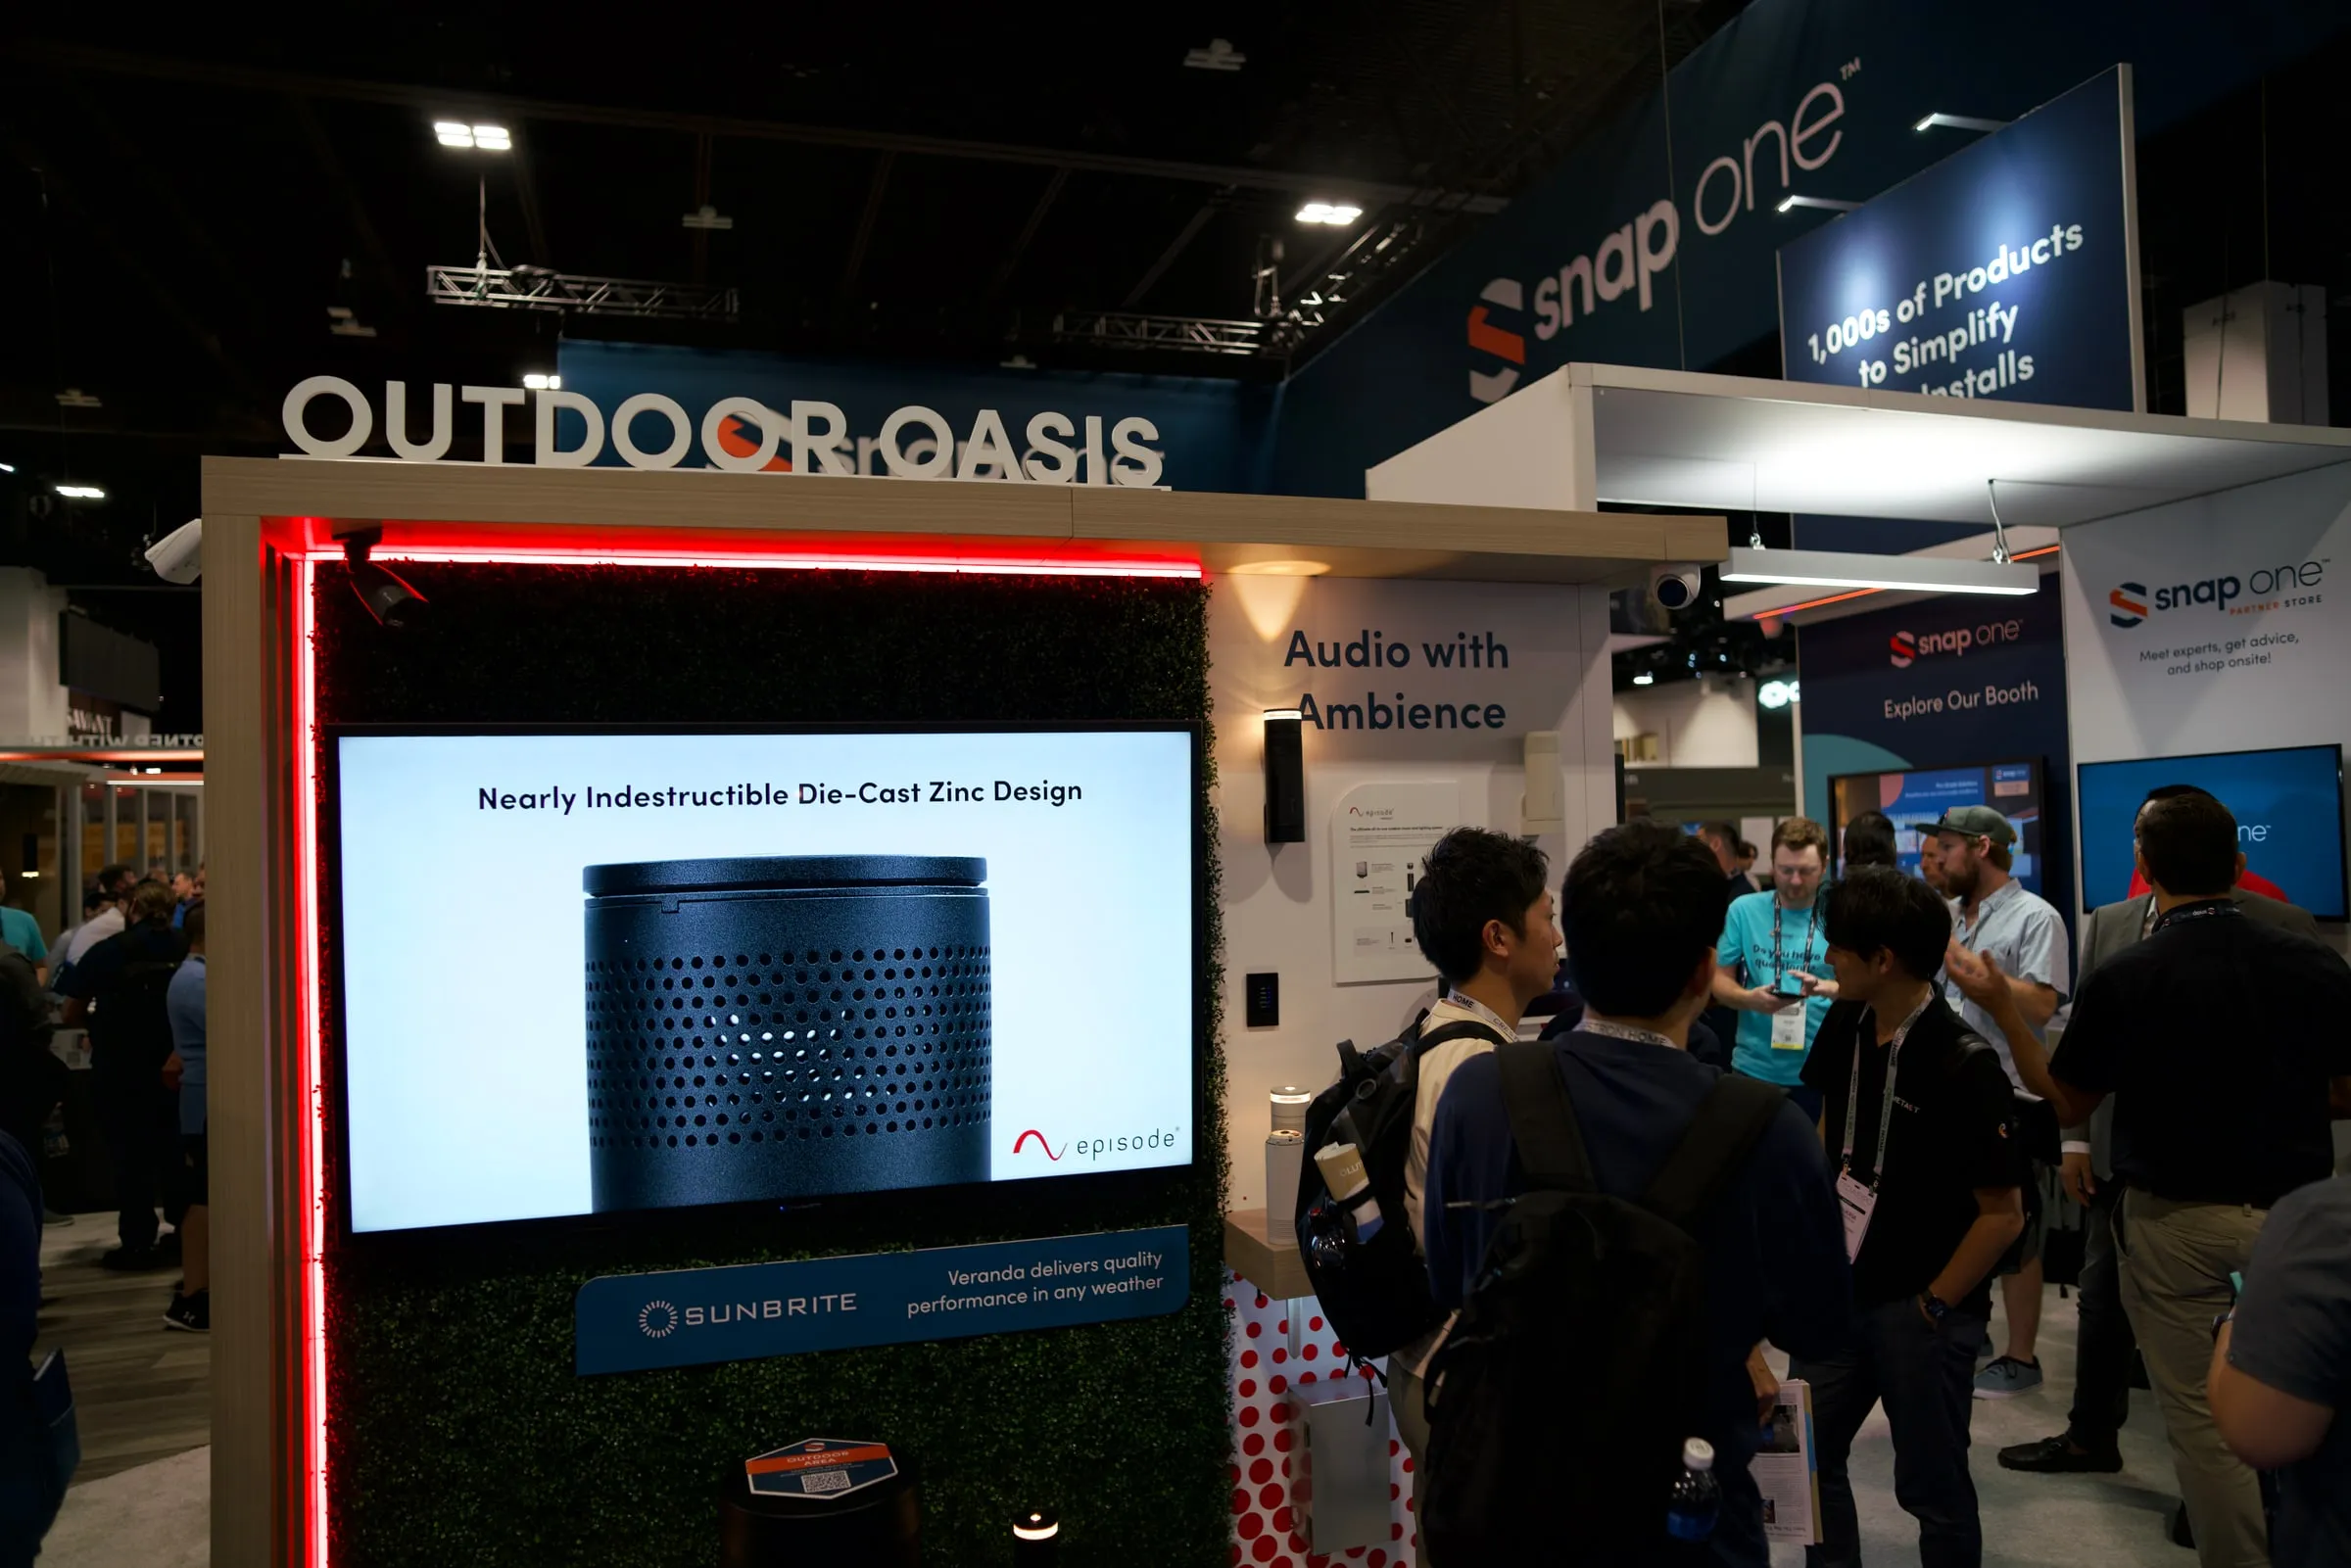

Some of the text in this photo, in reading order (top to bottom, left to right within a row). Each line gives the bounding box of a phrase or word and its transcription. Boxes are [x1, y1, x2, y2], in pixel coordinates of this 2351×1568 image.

[1534, 200, 1680, 340] snap
[1808, 223, 2084, 365] 1,000s of Products
[1858, 301, 2019, 388] to Simplify
[282, 375, 1164, 488] OUTDOOR OASIS
[2155, 575, 2241, 611] snap
[2230, 594, 2323, 616] PARTNER STORE
[1284, 630, 1509, 669] Audio with
[1918, 628, 1972, 656] snap
[2139, 632, 2299, 662] Meet experts, get advice,
[2167, 652, 2272, 676] and shop onsite!
[1299, 691, 1507, 730] Ambience
[1885, 680, 2039, 721] Explore Our Booth
[478, 779, 1082, 816] Nearly Indestructible Die-Cast Zinc Design
[1452, 992, 1474, 1009] HOME
[1628, 1030, 1667, 1045] HOME
[1077, 1127, 1176, 1162] episode
[948, 1251, 1163, 1286] Veranda delivers quality
[685, 1293, 858, 1326] SUNBRITE
[907, 1275, 1164, 1318] performance in any weather
[787, 1450, 849, 1464] OUTDOOR
[803, 1457, 838, 1467] AREA
